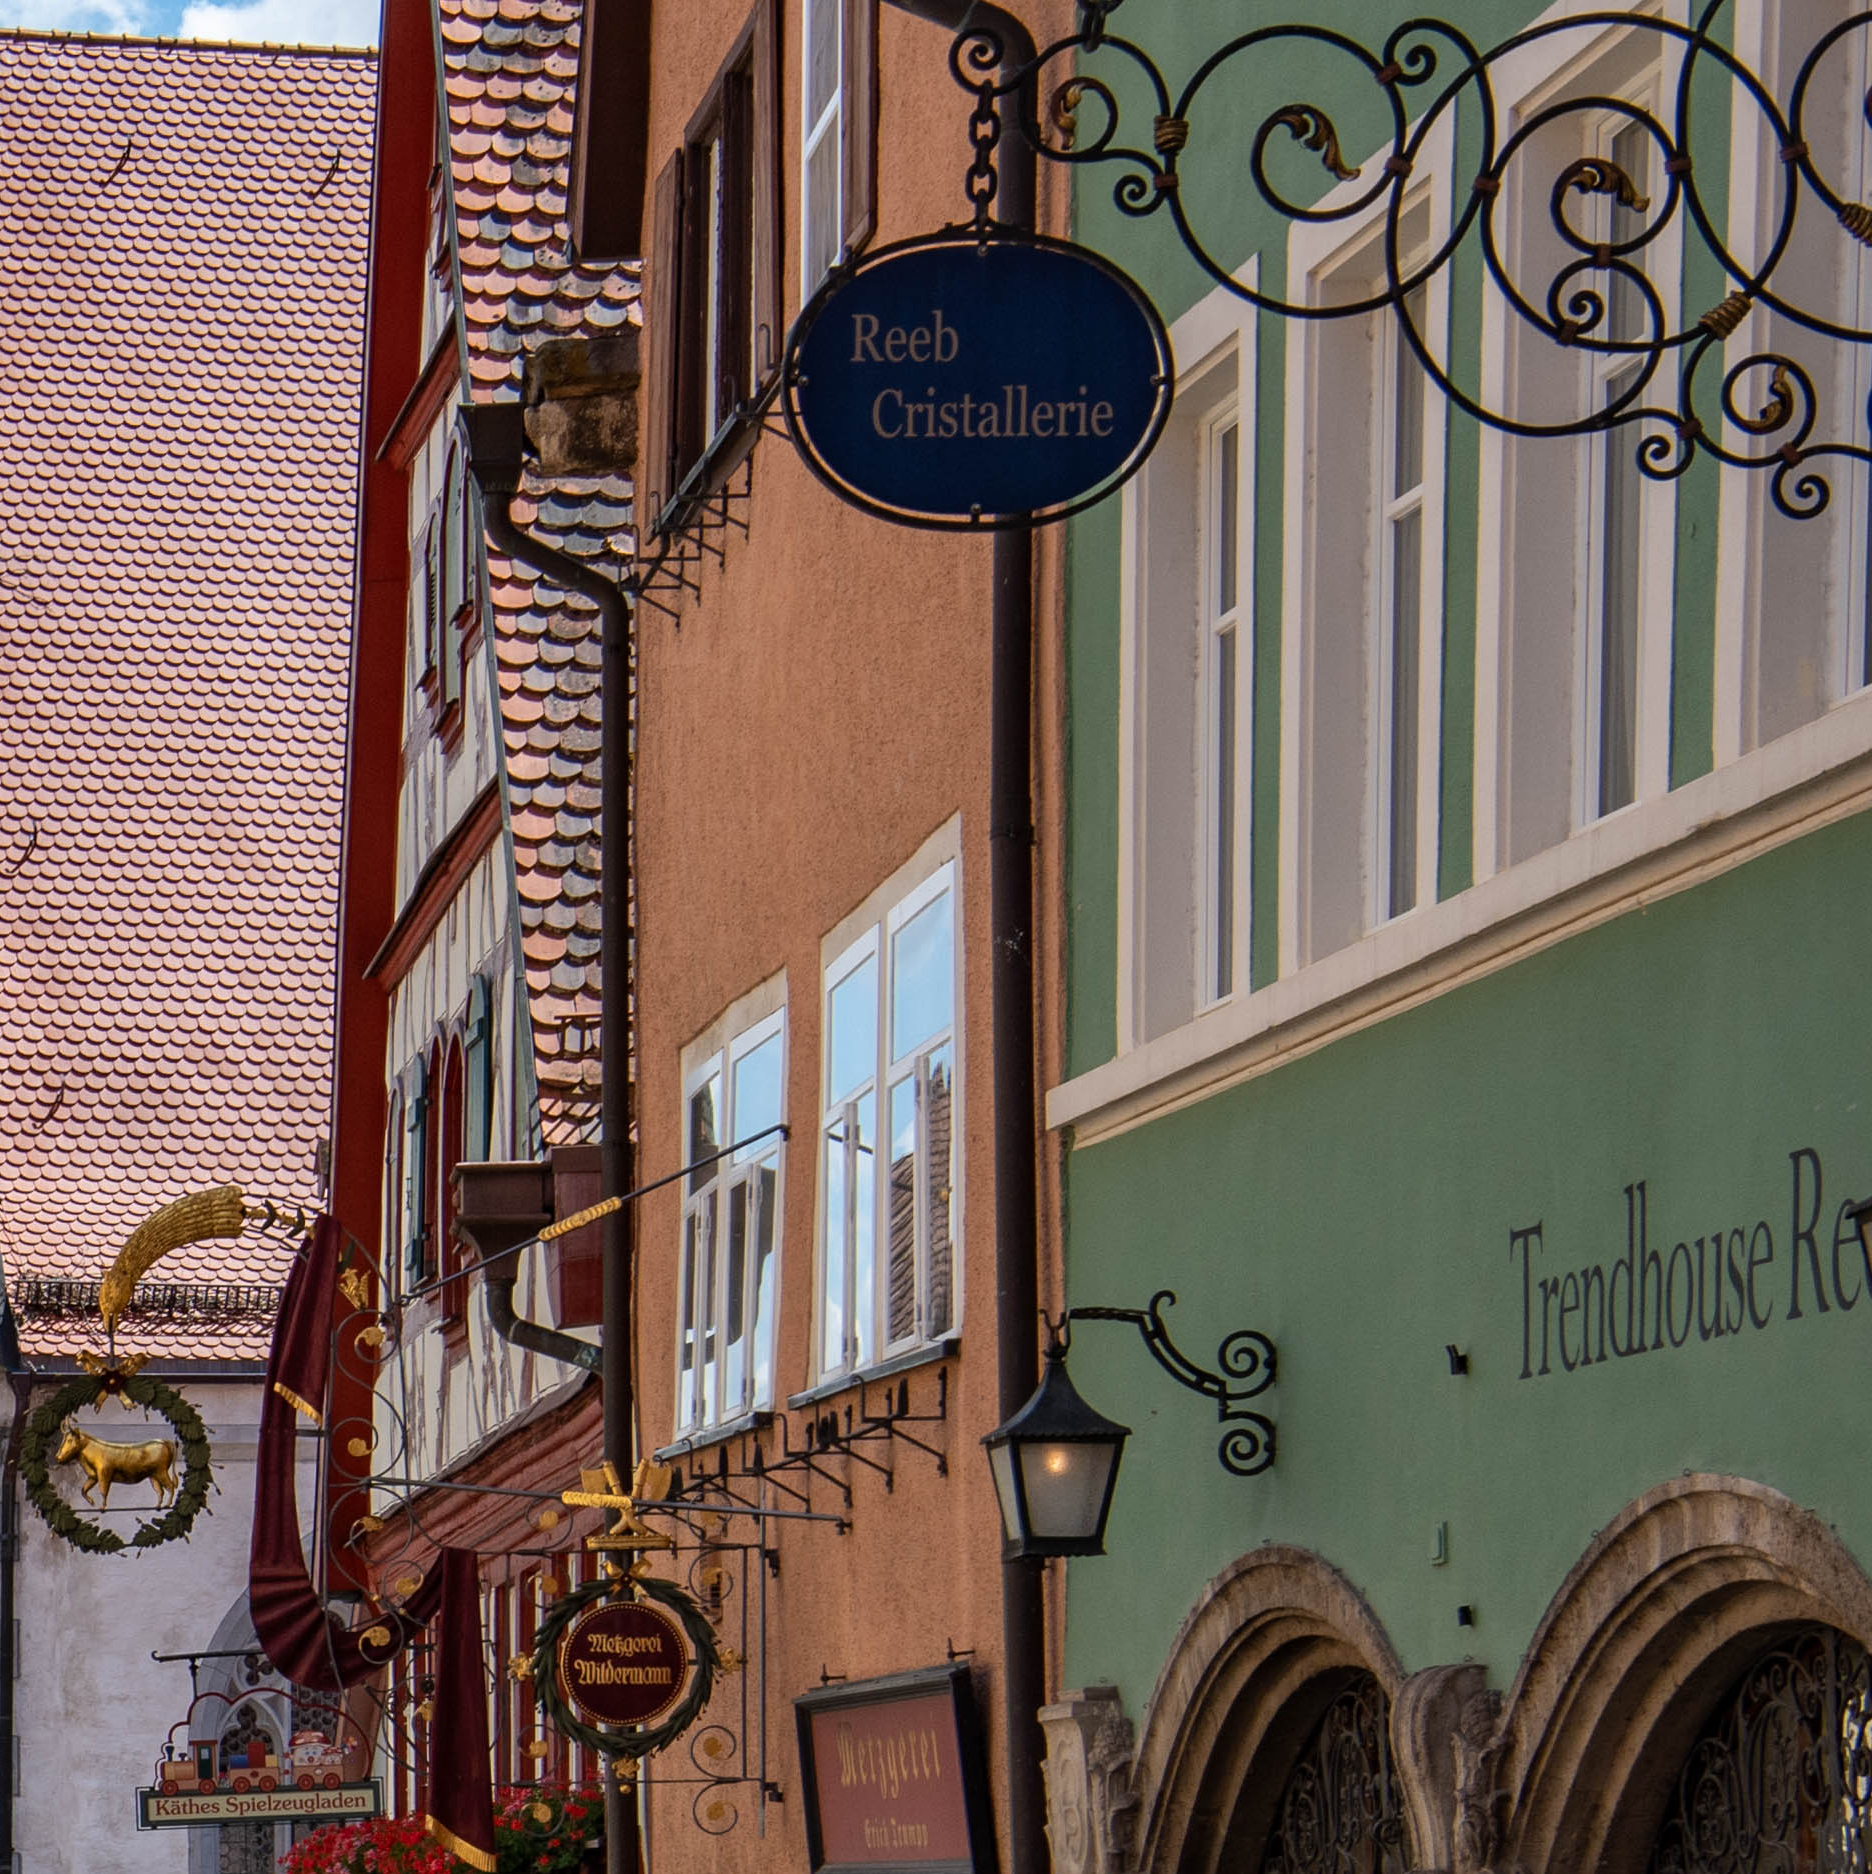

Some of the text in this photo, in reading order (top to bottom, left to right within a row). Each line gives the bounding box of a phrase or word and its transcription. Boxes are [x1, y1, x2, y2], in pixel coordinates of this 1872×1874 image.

[850, 310, 959, 364] Reeb
[872, 385, 1115, 439] Cristallerie
[1509, 1179, 1774, 1380] Trendhouse
[587, 1632, 663, 1657] Metzgerei
[573, 1658, 673, 1687] Wildermann
[836, 1720, 943, 1799] Metzgerei
[154, 1791, 367, 1819] Käthes Spielzeugladen
